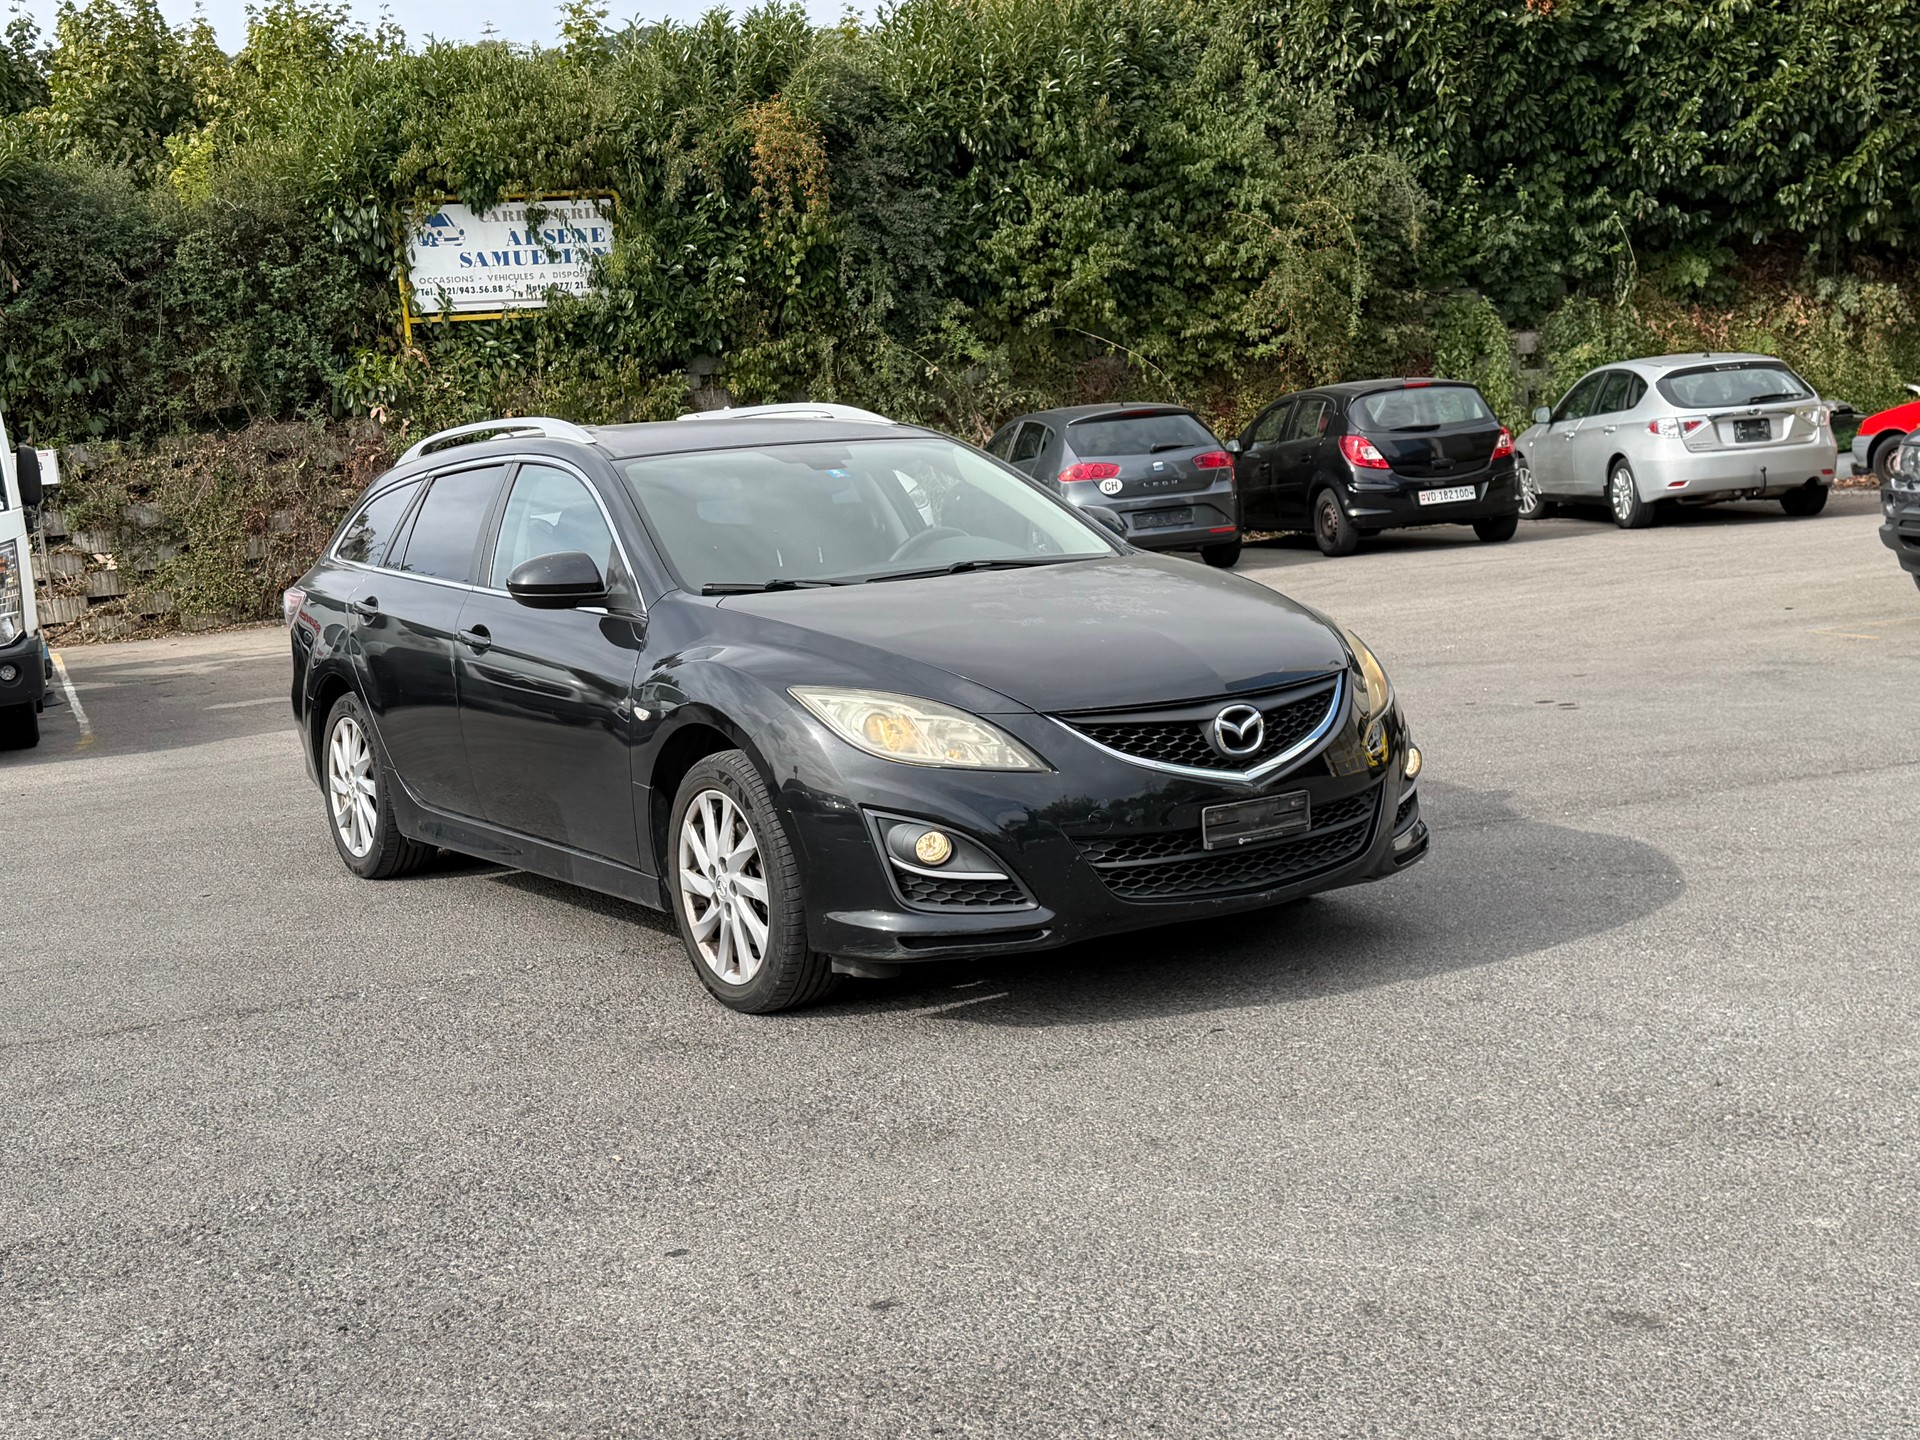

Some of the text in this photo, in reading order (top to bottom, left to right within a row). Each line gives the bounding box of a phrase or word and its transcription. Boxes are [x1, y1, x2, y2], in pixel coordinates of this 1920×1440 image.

[419, 275, 475, 285] OCCASIONS
[487, 272, 535, 282] VEHICULES
[539, 272, 546, 280] A
[420, 287, 436, 296] Tél.
[441, 285, 503, 296] 21/943.56.88
[1104, 481, 1118, 492] CH
